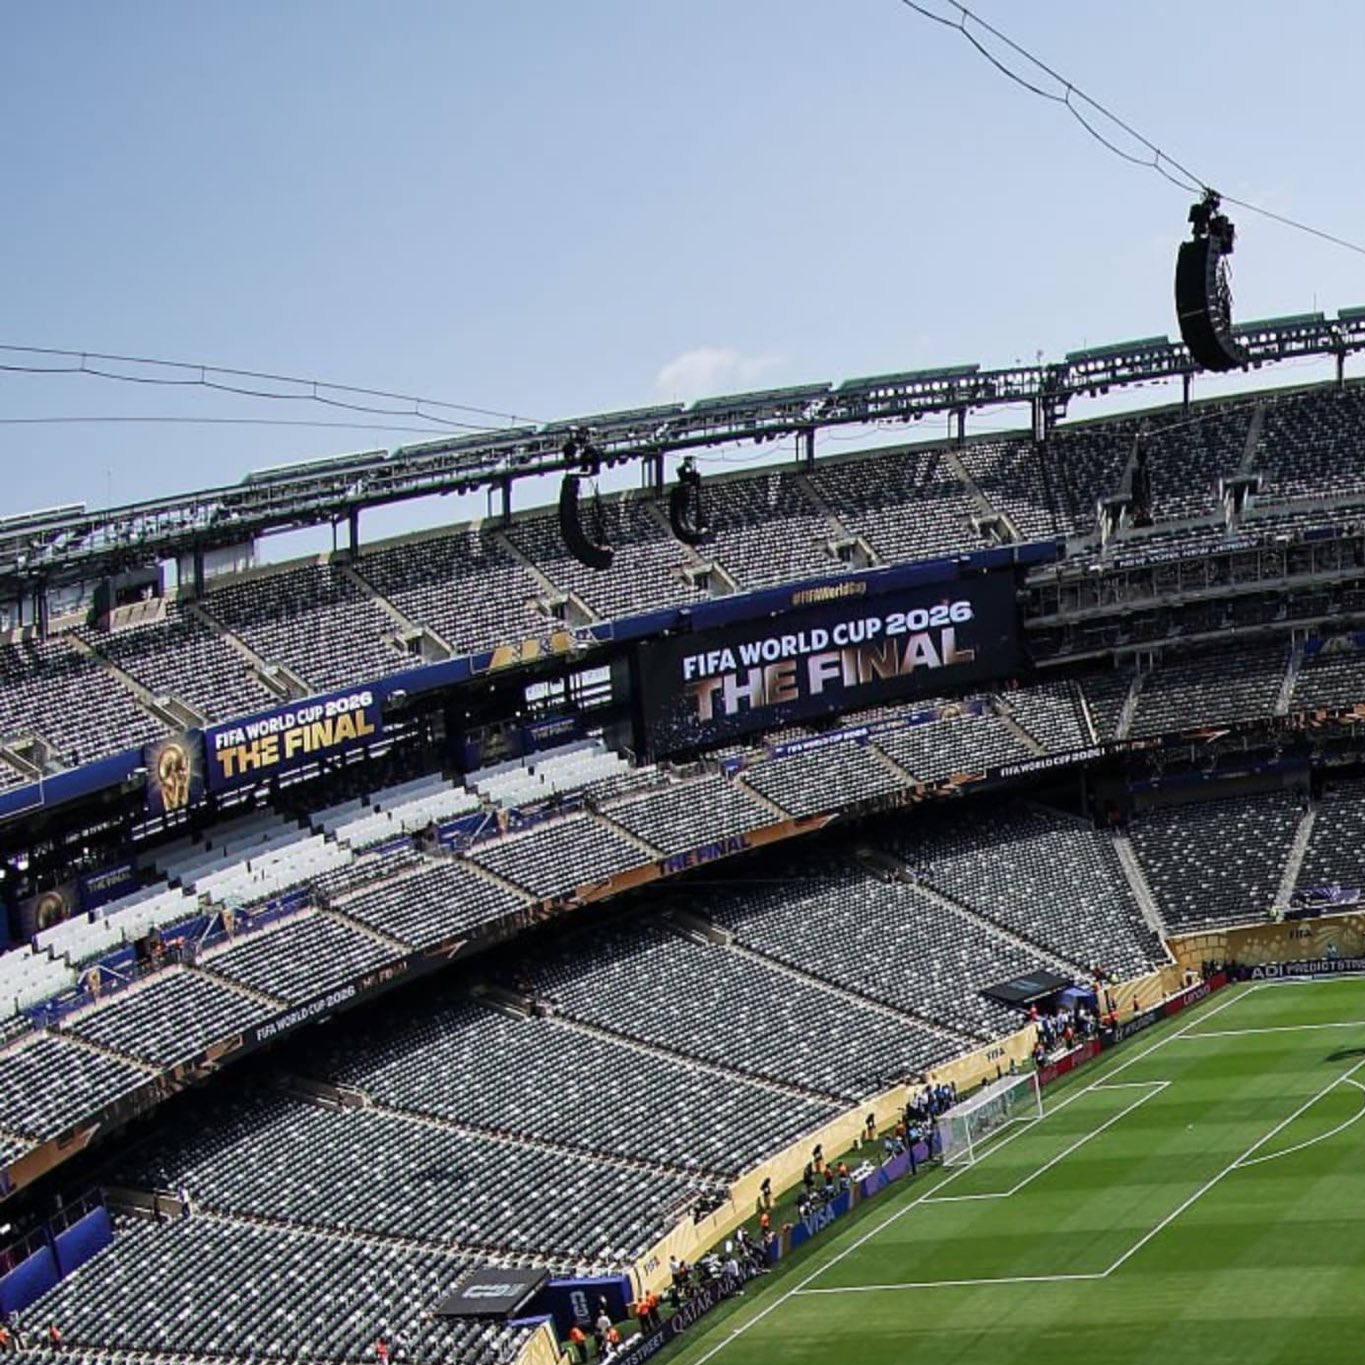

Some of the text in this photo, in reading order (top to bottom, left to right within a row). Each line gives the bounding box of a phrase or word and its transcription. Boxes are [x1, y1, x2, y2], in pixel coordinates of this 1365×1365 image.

[683, 600, 973, 680] FIFA WORLD CUP 2026
[687, 626, 976, 722] THE FINAL
[215, 691, 373, 749] FIFA WORLD CUP 2026
[216, 710, 375, 778] THE FINAL
[1001, 767, 1020, 778] FIFA
[1020, 758, 1053, 772] WORLD
[1053, 753, 1070, 766] CUP
[1251, 963, 1285, 980] ADI
[256, 1024, 276, 1041] FIFA
[277, 1007, 309, 1030] WORLD
[326, 985, 356, 1008] 2026
[672, 1294, 714, 1333] QATAR
